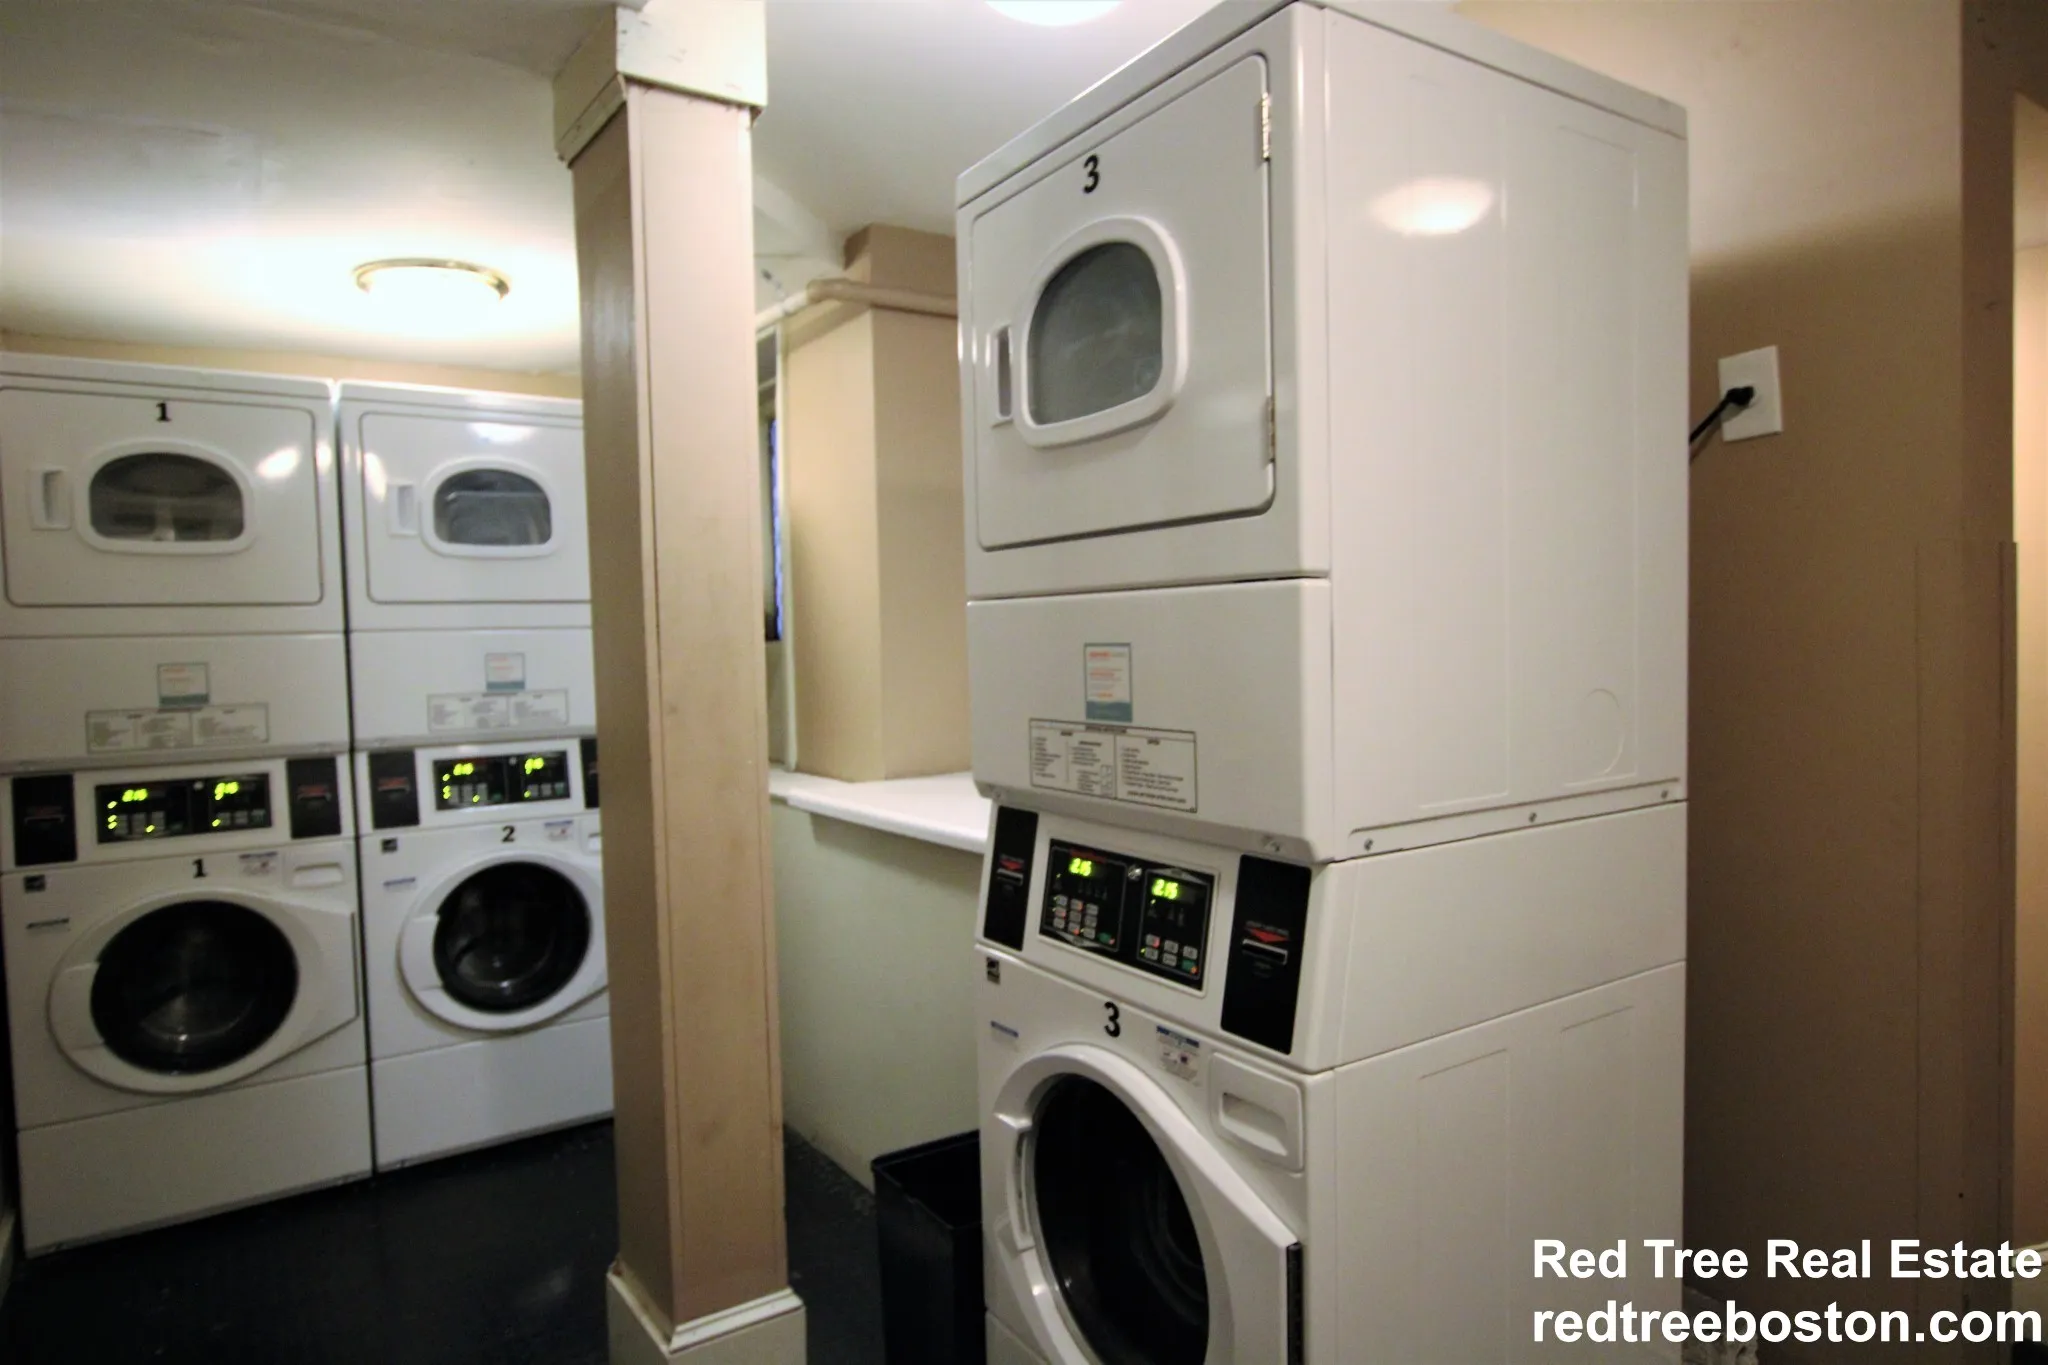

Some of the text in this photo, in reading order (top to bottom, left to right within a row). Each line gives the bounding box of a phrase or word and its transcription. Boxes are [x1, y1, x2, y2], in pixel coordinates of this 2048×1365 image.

[1083, 154, 1101, 194] 3
[155, 401, 171, 423] 1
[502, 825, 516, 843] 2
[191, 856, 208, 879] 1
[1103, 1001, 1121, 1038] 3
